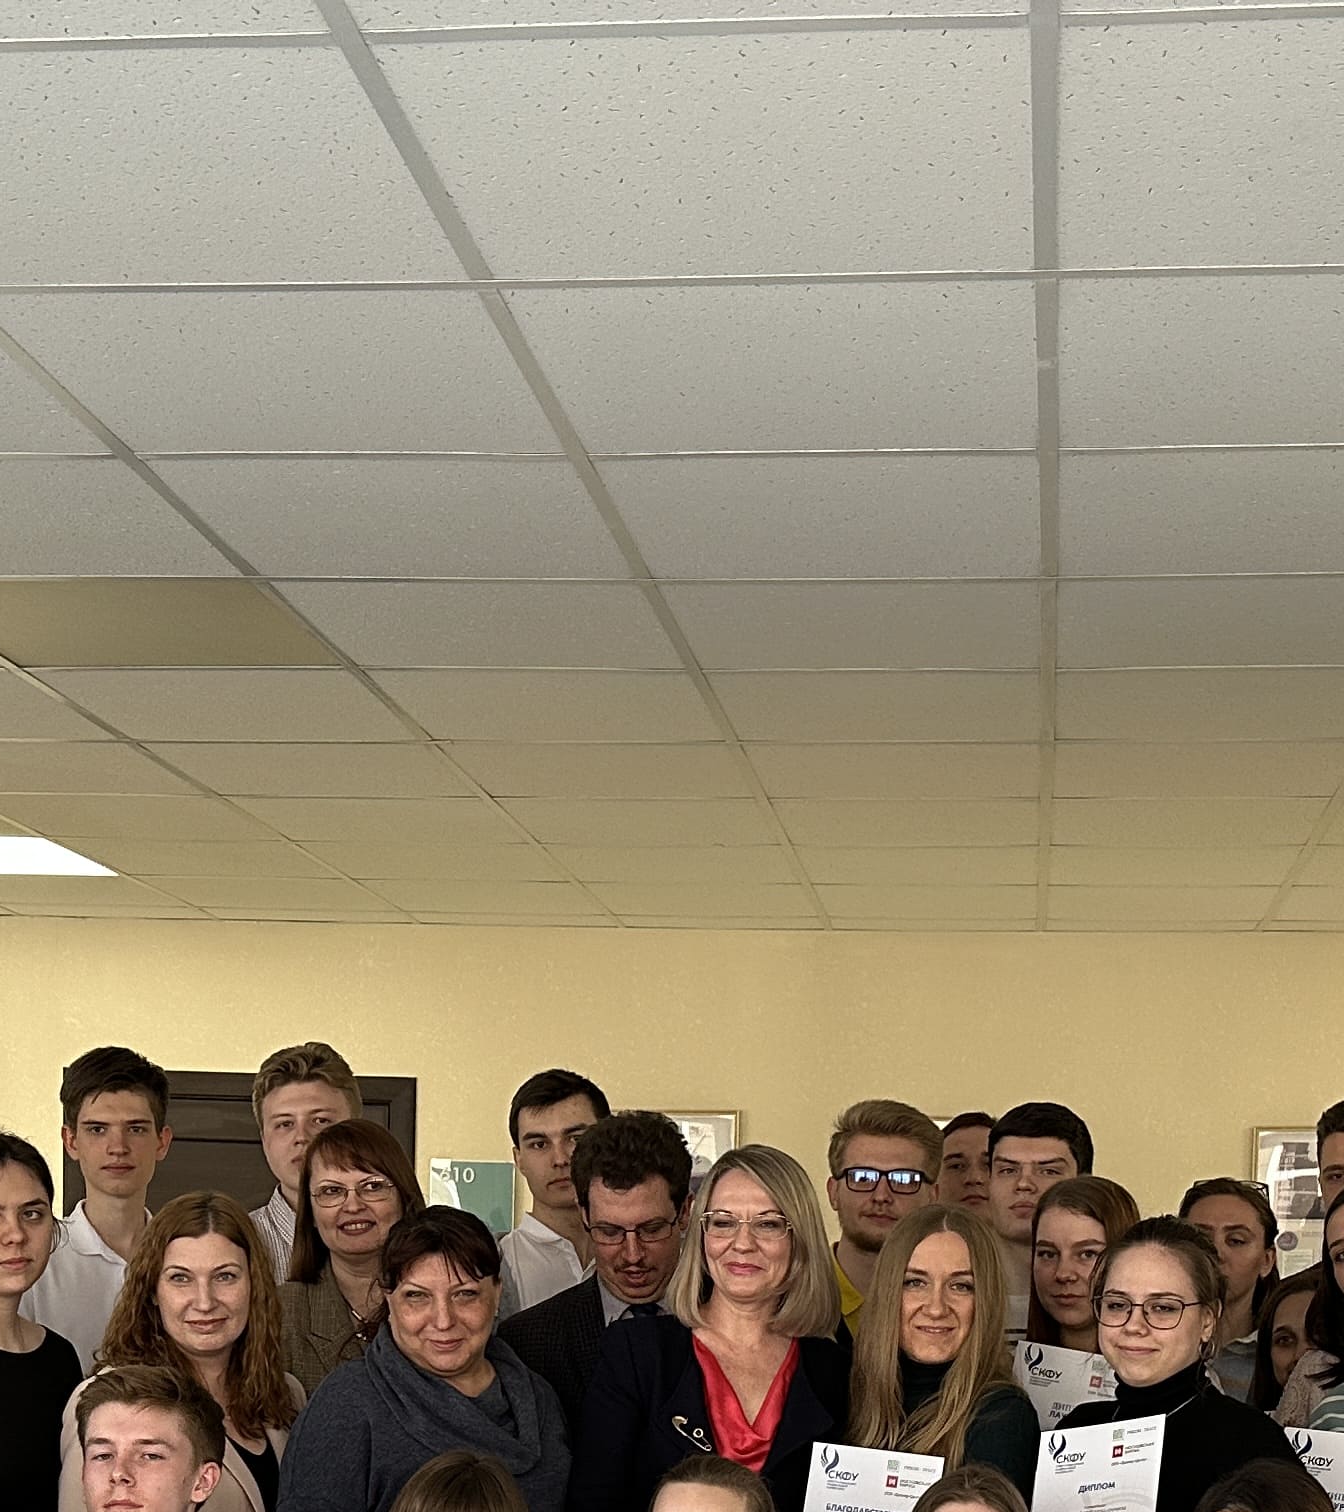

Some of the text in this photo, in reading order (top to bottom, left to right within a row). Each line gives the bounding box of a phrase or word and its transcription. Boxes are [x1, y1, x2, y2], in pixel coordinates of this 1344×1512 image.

[440, 1167, 475, 1183] 610
[1031, 1367, 1063, 1379] СКФУ
[1056, 1452, 1086, 1464] СКФУ
[1299, 1455, 1334, 1467] СКФУ
[828, 1470, 859, 1482] СКФУ
[1078, 1482, 1116, 1494] ДИПЛОМ
